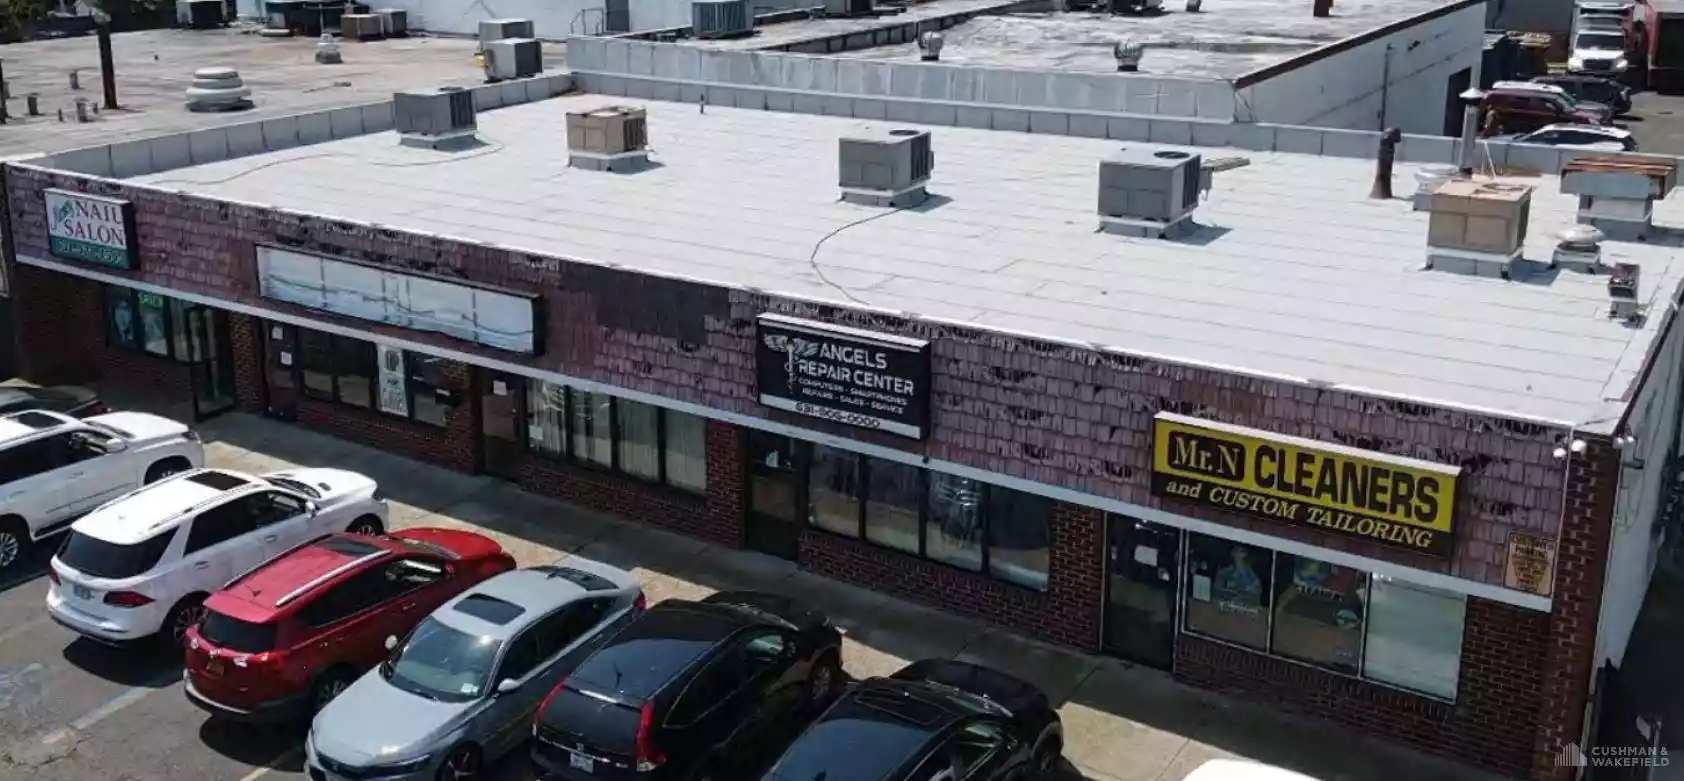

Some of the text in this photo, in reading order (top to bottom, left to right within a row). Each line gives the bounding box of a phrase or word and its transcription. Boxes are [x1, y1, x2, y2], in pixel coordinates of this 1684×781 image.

[74, 200, 123, 224] NAIL
[64, 219, 124, 245] SALON
[819, 342, 887, 369] ANGELS
[798, 360, 915, 396] REPAIR CENTER
[1173, 436, 1440, 523] Mr.N CLEANERS
[1166, 480, 1433, 549] and CUSTOM TAILORING
